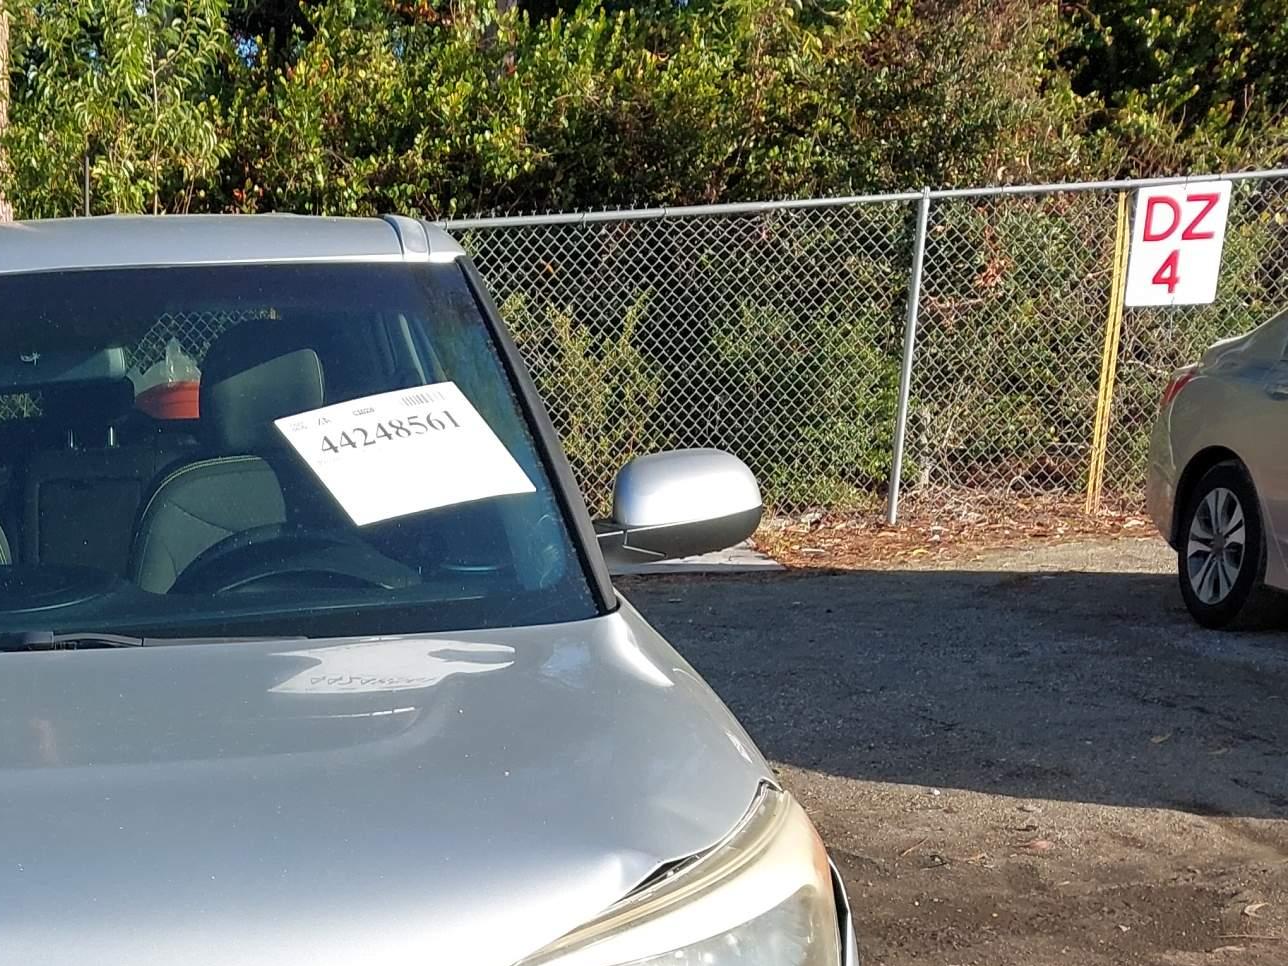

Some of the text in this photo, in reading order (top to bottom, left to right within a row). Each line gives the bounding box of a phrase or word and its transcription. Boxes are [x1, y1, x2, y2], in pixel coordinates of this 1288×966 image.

[1143, 193, 1221, 241] DZ
[1152, 249, 1180, 294] 4
[321, 410, 461, 453] 44248561
